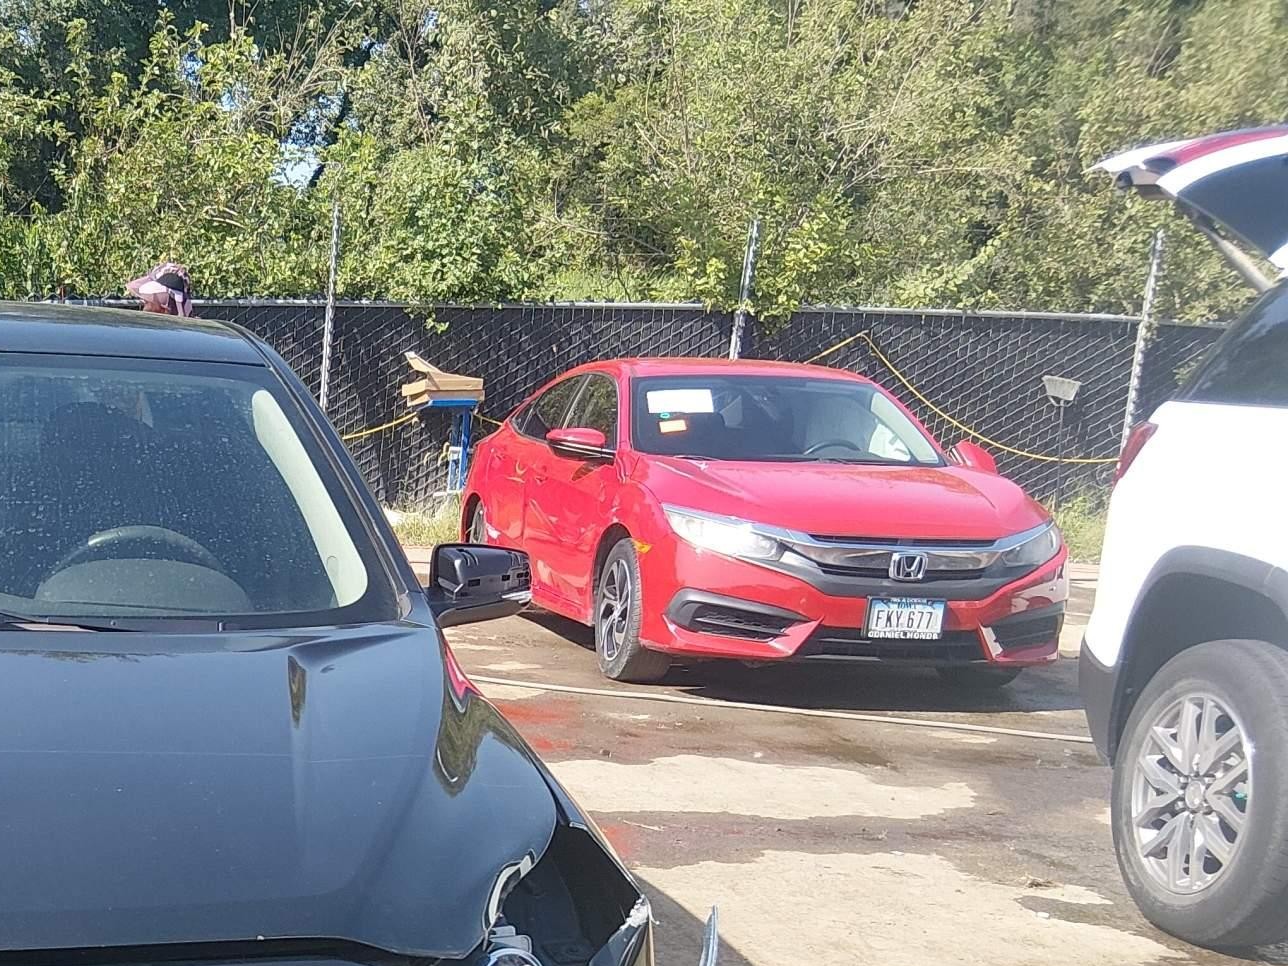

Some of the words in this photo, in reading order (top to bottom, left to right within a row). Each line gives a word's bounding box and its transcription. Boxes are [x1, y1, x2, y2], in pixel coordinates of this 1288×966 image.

[875, 609, 902, 628] FKY
[907, 610, 933, 629] 677
[906, 631, 938, 640] HONDA
